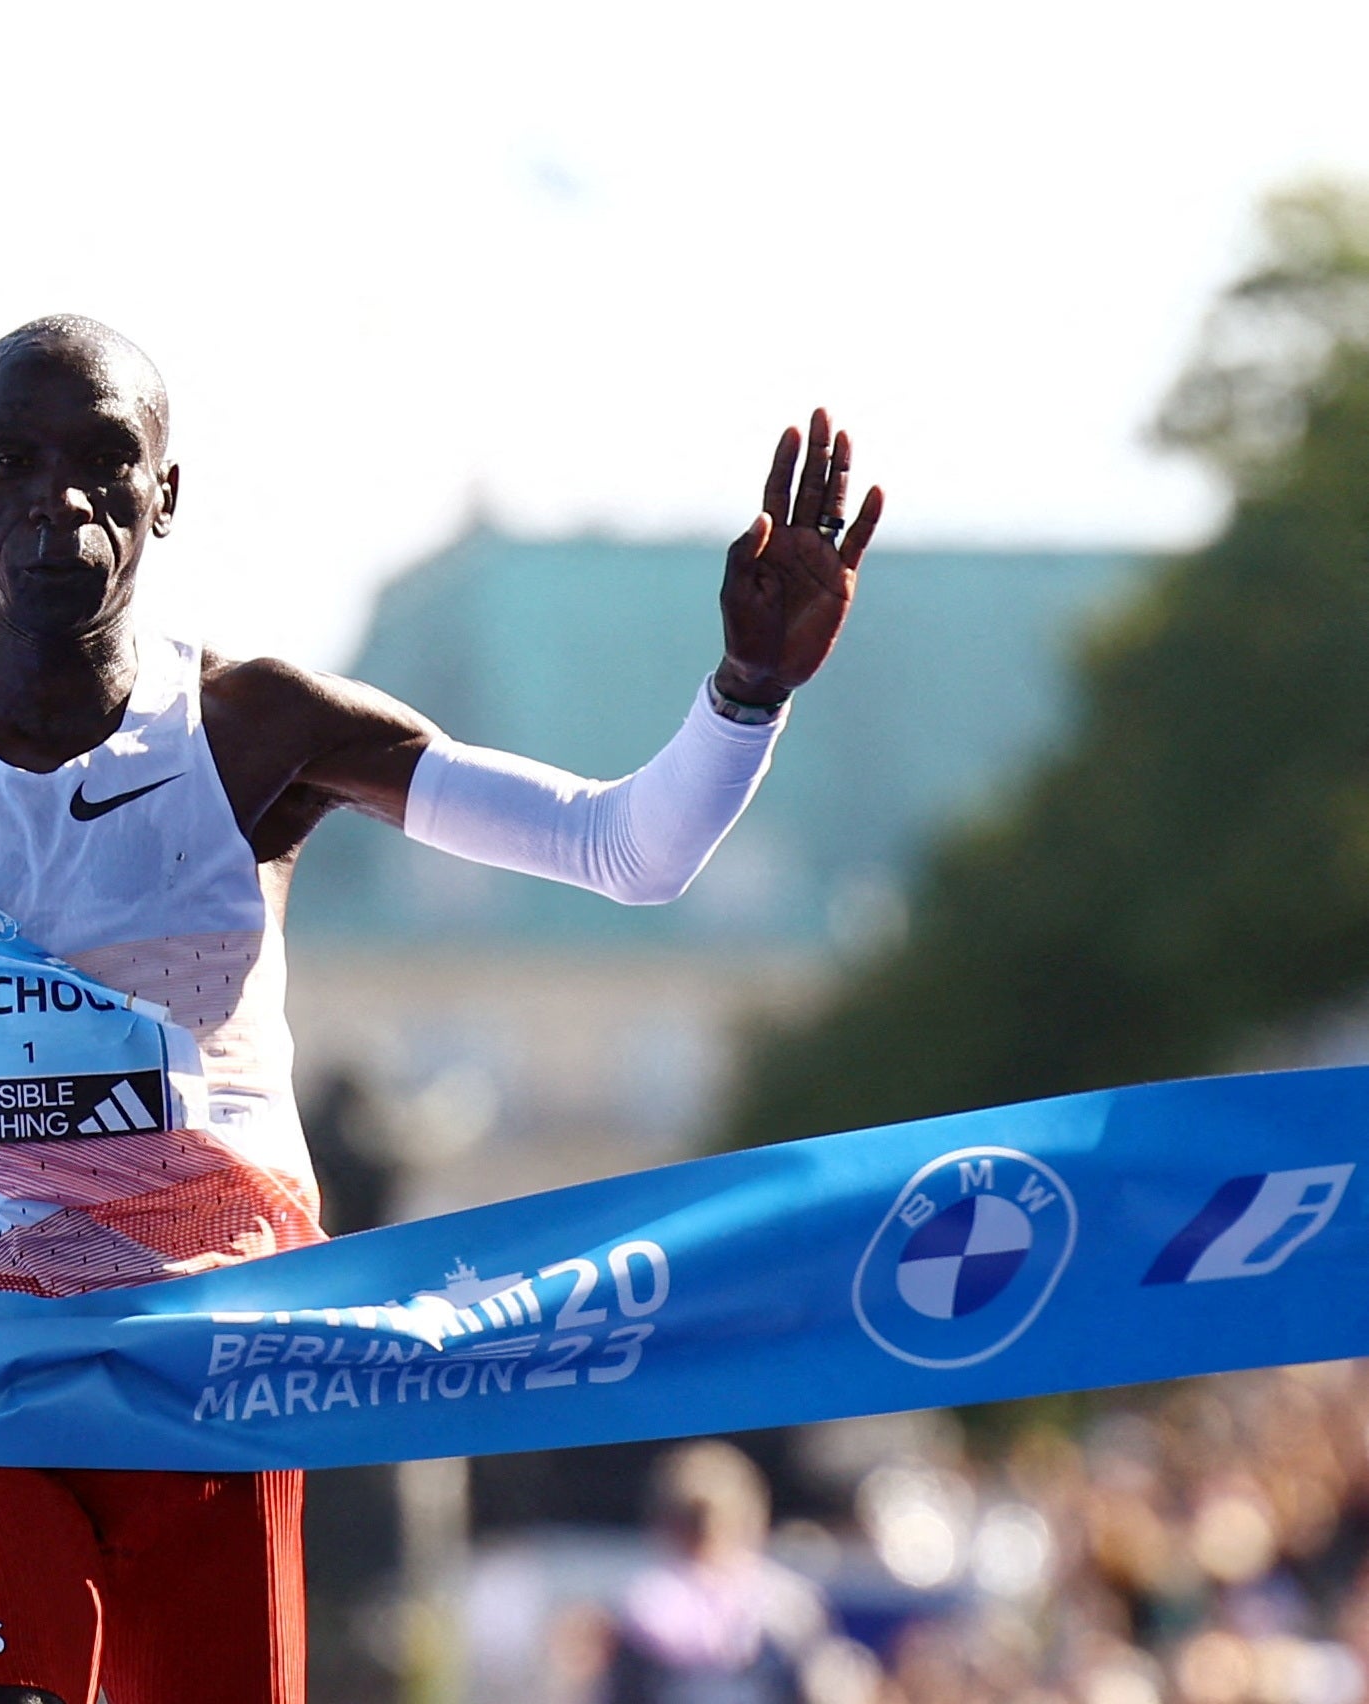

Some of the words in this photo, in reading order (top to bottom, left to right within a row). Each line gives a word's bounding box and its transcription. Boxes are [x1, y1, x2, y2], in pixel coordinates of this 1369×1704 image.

[22, 1041, 35, 1064] 1
[898, 1158, 1058, 1229] BMW
[538, 1239, 671, 1330] 20
[193, 1357, 519, 1422] MARATHON
[525, 1322, 656, 1391] 23
[208, 1333, 426, 1377] BERLIN
